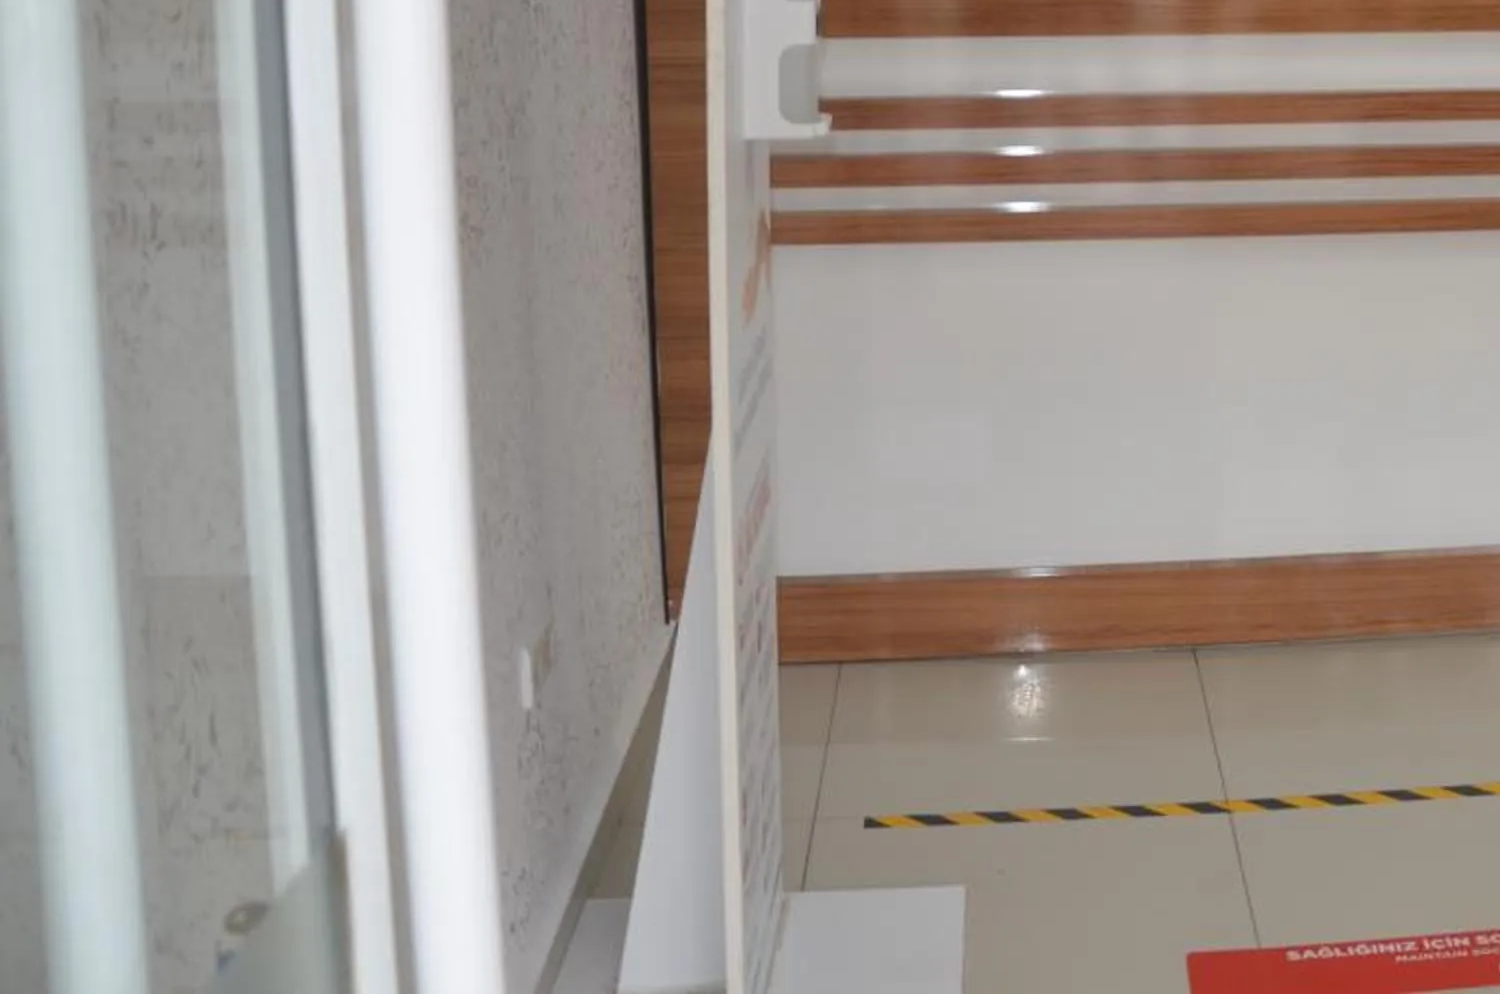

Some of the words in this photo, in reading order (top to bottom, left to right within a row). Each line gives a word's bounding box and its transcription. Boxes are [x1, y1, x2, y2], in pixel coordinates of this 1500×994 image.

[1286, 941, 1419, 961] SAĞLIĞINIZ
[1423, 936, 1470, 952] İÇİN
[1395, 950, 1468, 963] MAINTAIN
